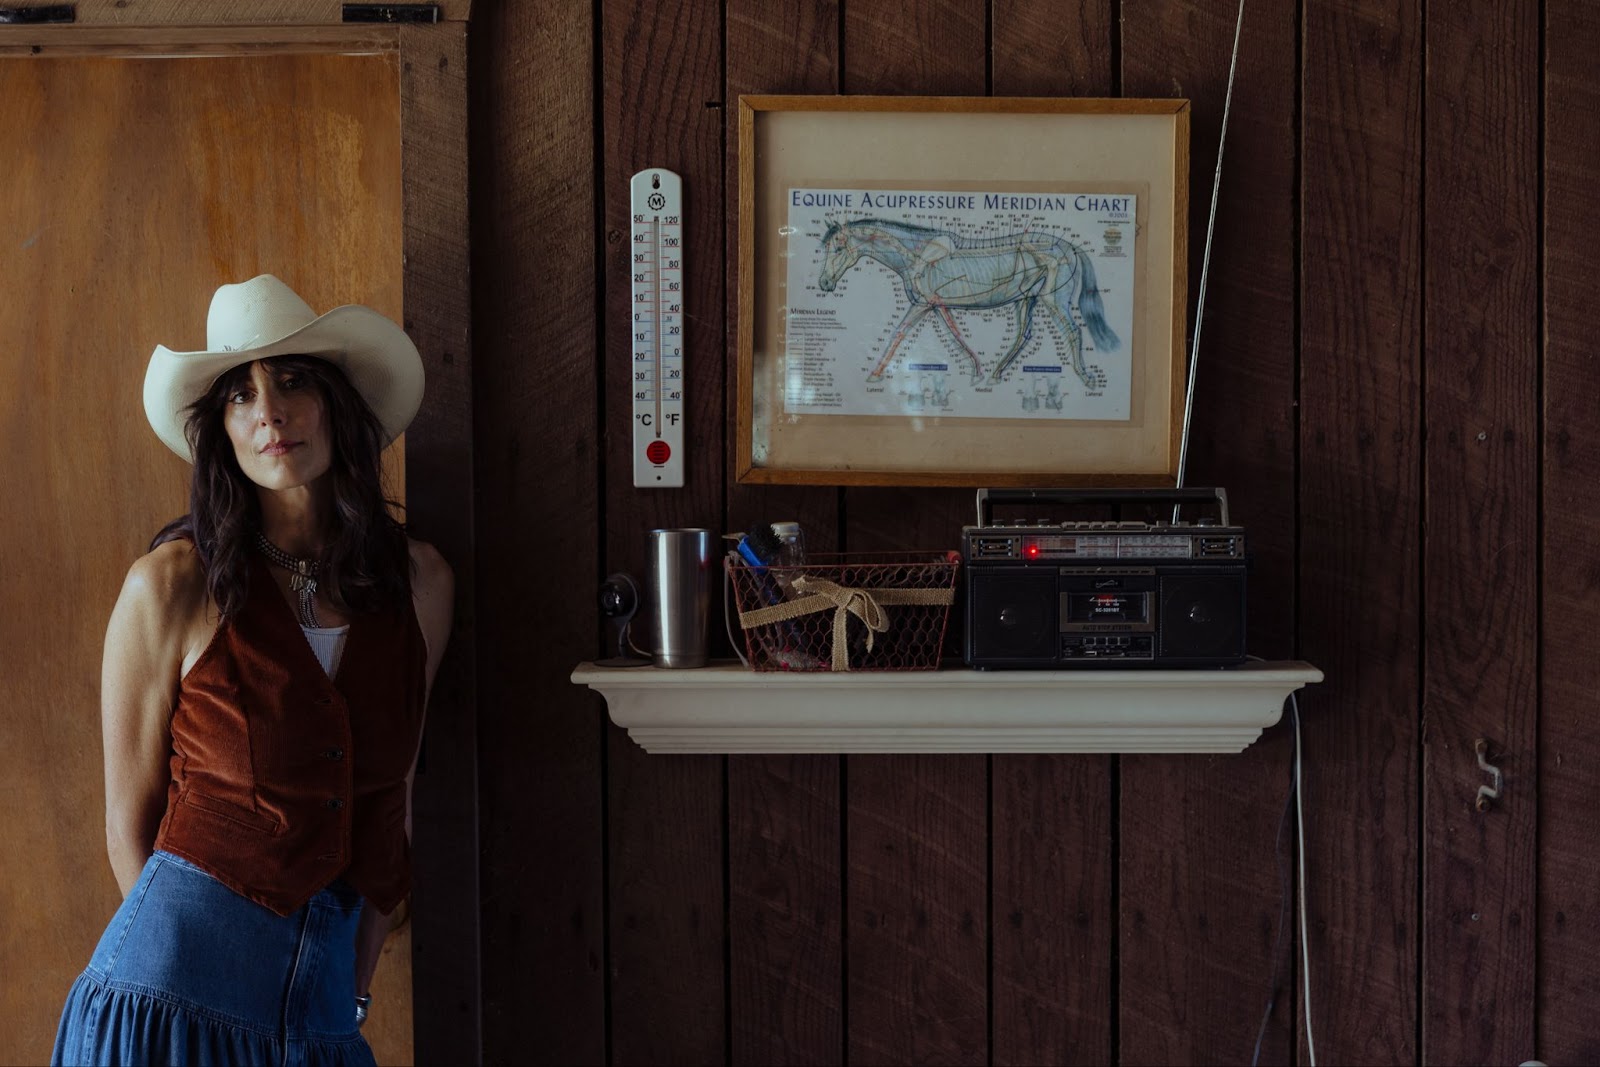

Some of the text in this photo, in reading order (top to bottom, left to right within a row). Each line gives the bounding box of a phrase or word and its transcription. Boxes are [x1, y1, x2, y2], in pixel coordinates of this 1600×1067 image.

[792, 190, 1130, 211] EQUINE ACUPRESSURE MERIDIAN CHART
[636, 413, 652, 426] °C
[665, 413, 680, 426] °F
